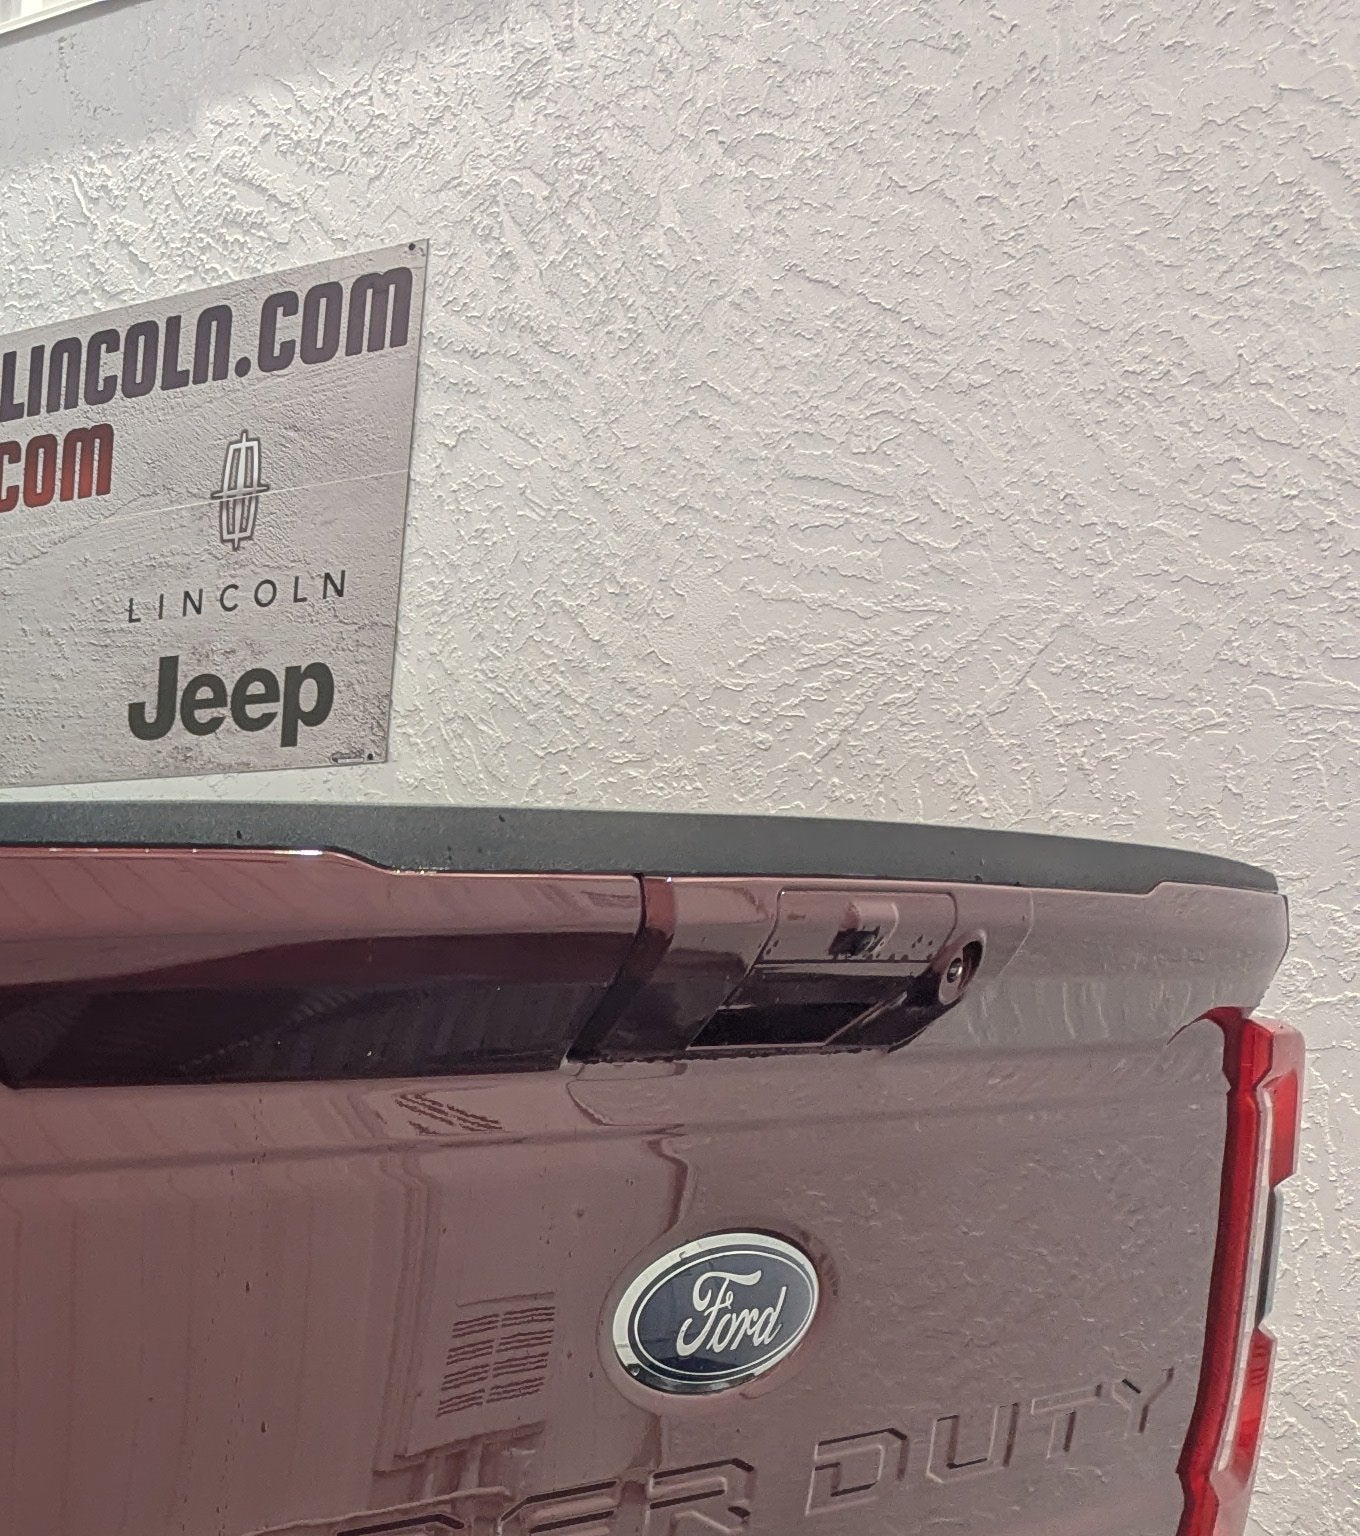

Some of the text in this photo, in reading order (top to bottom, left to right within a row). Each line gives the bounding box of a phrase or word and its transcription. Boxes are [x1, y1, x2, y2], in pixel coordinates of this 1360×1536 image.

[127, 569, 347, 624] LINCOLN
[128, 655, 335, 748] Jeep
[676, 1270, 787, 1357] Ford
[805, 1366, 1175, 1516] DUTY
